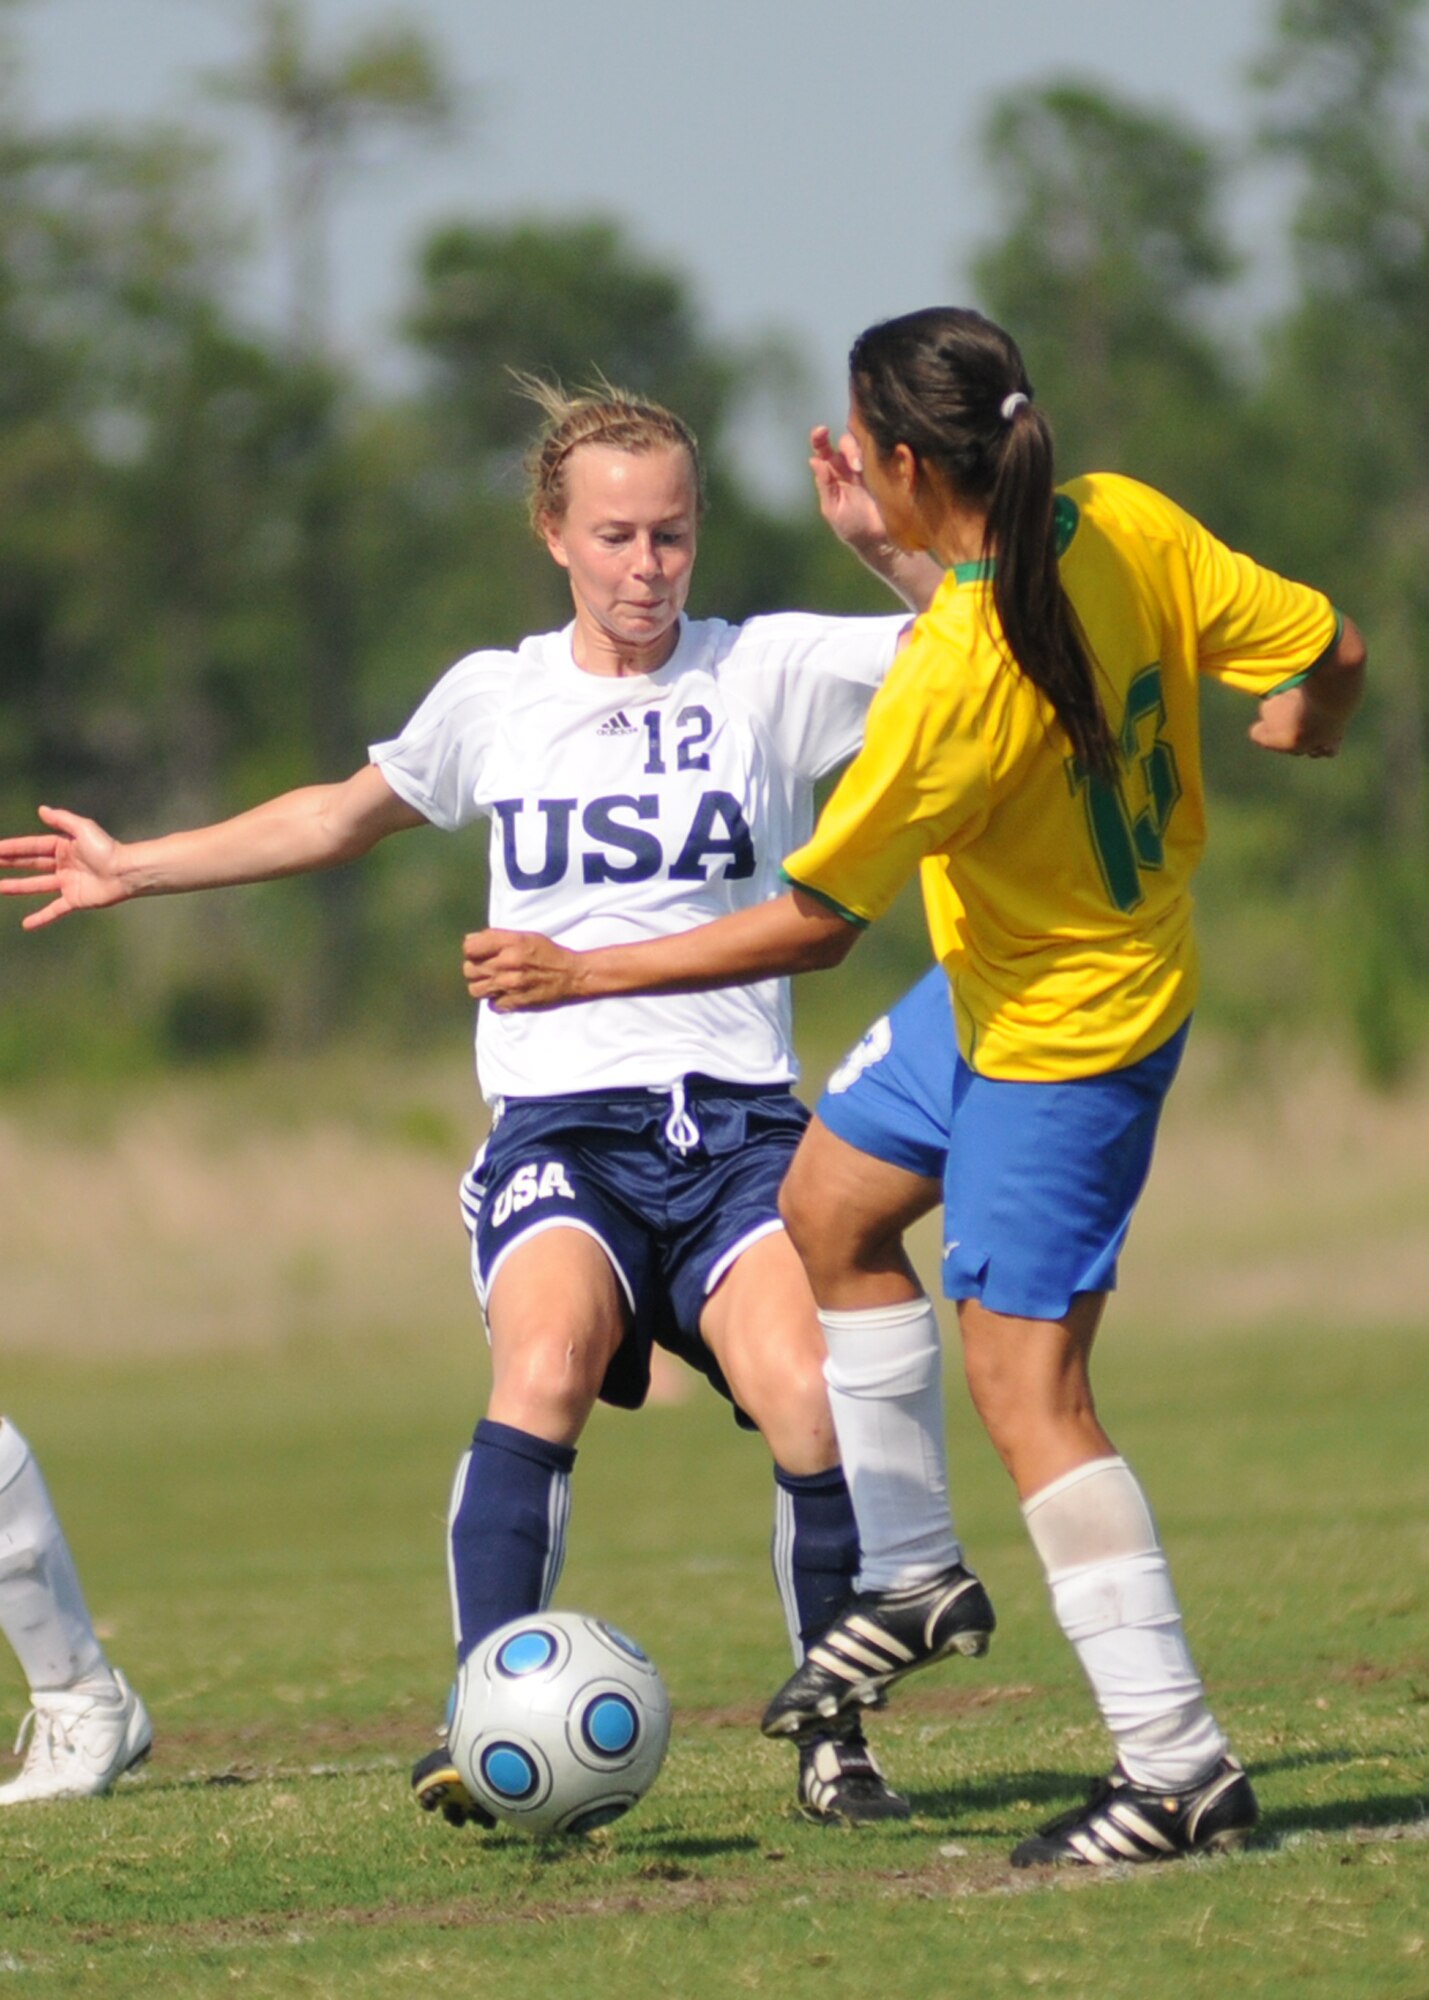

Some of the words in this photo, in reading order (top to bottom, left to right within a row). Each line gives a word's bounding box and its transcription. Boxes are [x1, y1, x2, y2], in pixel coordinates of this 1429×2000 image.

[643, 705, 712, 774] 12
[493, 790, 756, 891] USA
[491, 1161, 576, 1228] USA
